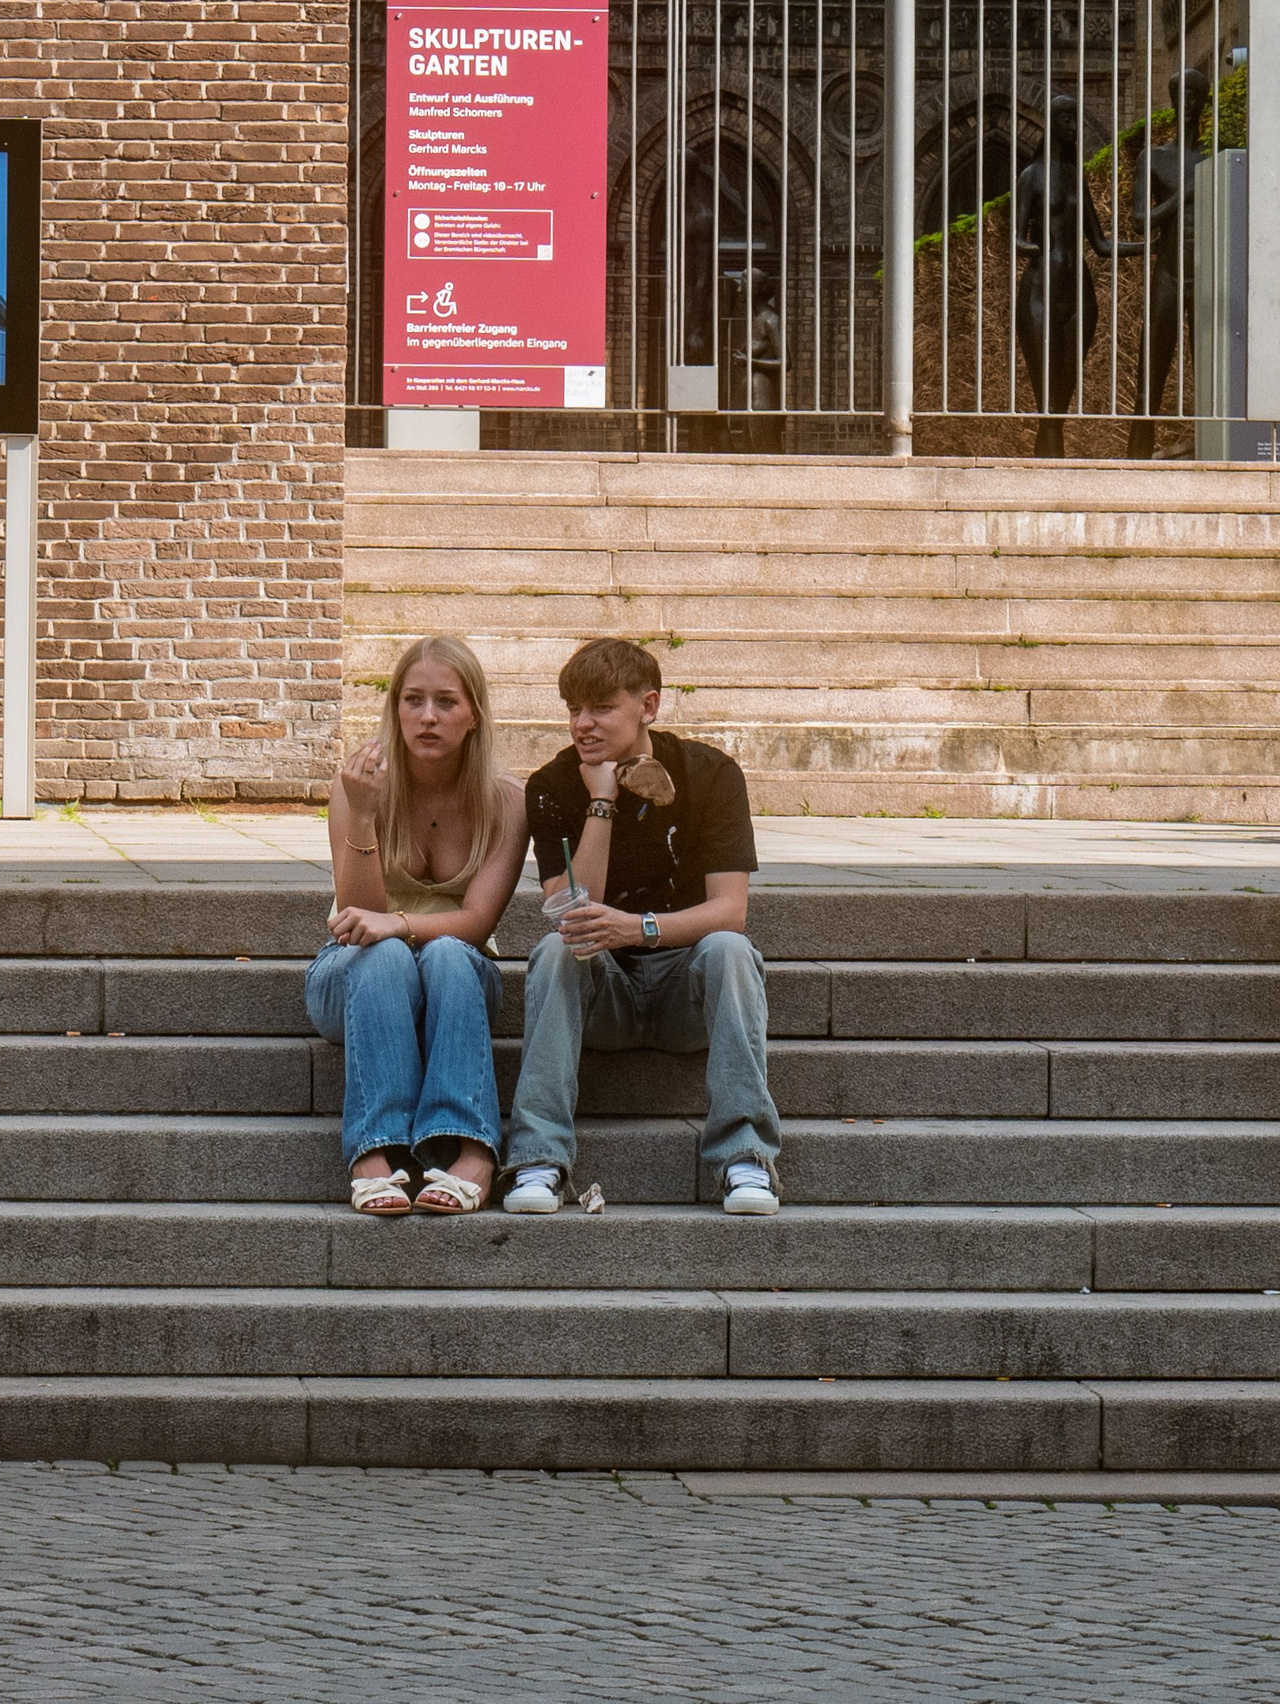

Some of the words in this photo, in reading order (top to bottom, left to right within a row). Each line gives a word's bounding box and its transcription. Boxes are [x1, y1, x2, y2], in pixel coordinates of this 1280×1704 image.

[409, 28, 583, 50] SKULPTUREN-
[409, 55, 507, 76] GARTEN
[409, 93, 449, 102] Entwurf
[452, 93, 471, 103] und
[474, 94, 533, 106] Ausführung
[410, 107, 450, 116] Manfred
[453, 107, 502, 117] Schomers
[409, 130, 464, 141] Skulpturen
[409, 144, 449, 153] Gerhard
[452, 144, 487, 154] Marcks
[408, 165, 487, 178] Öffnungszeiten
[527, 182, 545, 191] Uhr
[407, 323, 476, 333] Barrierefreier
[478, 324, 517, 335] Zugang
[407, 337, 419, 346] im
[422, 337, 524, 349] gegenüberliegenden
[527, 338, 567, 350] Eingang
